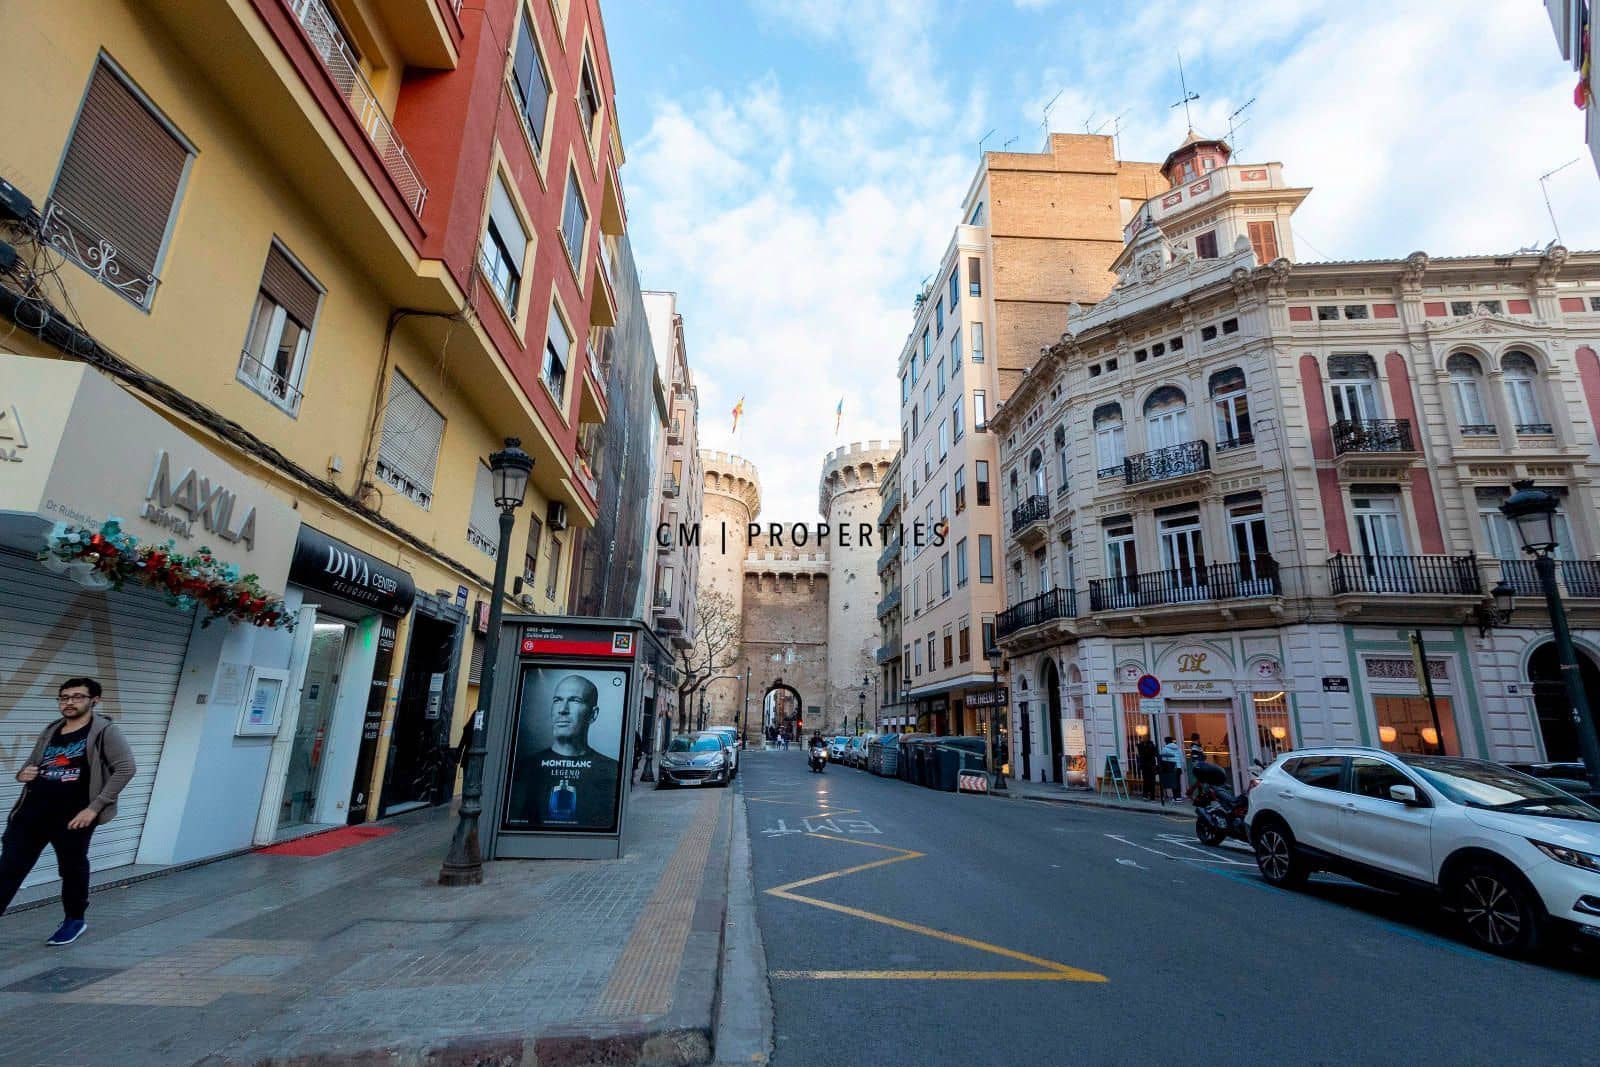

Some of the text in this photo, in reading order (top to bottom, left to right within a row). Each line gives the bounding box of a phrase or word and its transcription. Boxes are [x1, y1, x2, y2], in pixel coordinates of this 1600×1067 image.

[322, 544, 398, 593] DIVA CENTER
[541, 759, 592, 768] MONTBLANC
